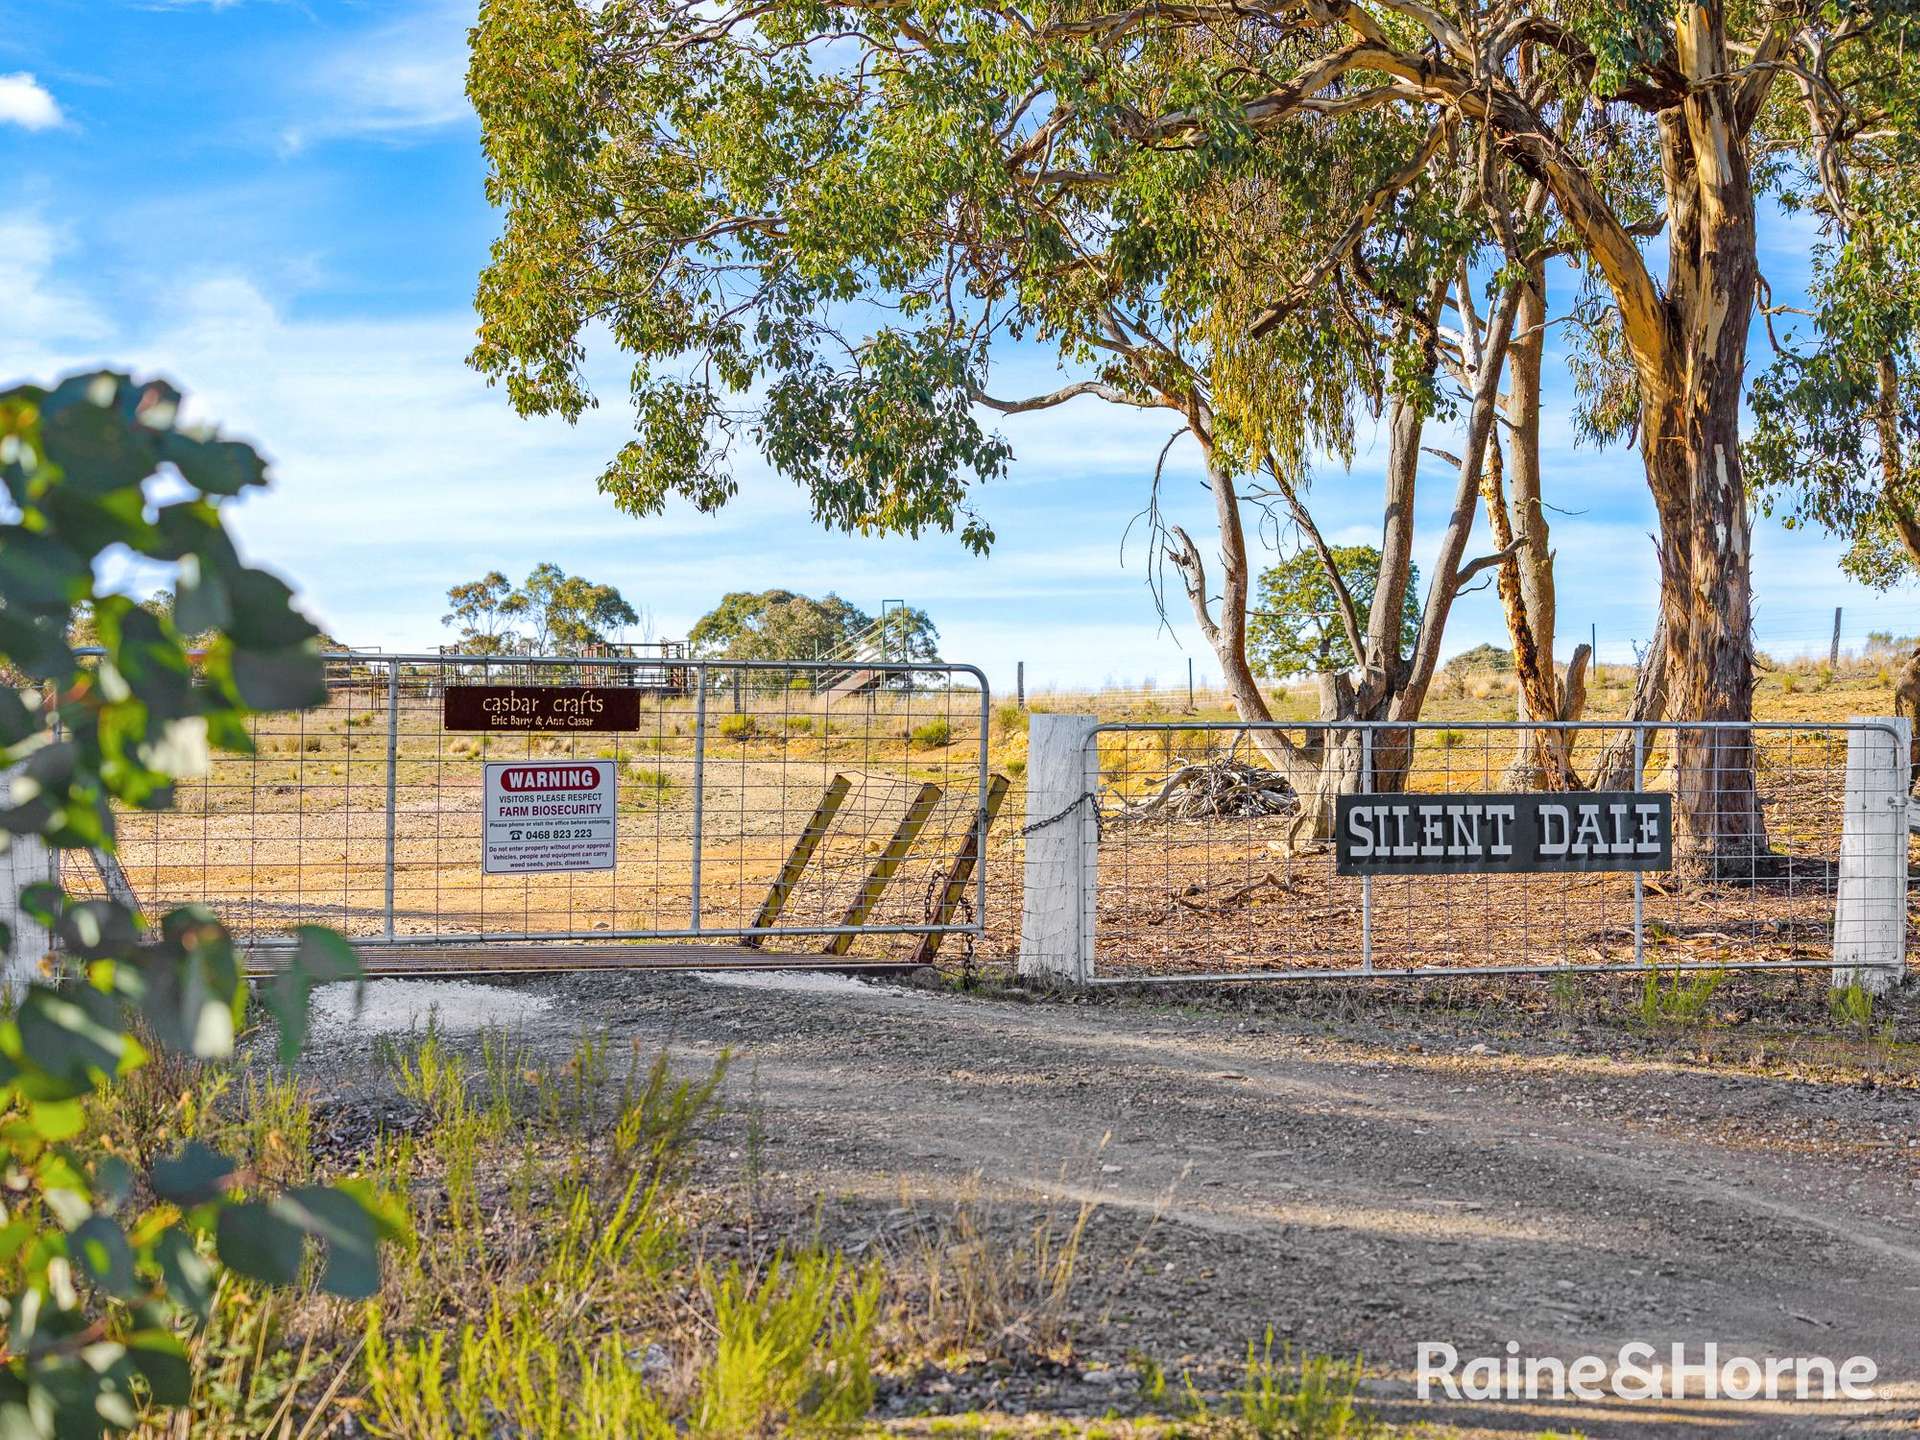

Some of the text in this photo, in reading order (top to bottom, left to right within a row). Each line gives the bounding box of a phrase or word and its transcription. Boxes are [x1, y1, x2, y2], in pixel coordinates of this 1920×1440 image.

[482, 690, 604, 715] casbar crafts
[491, 715, 594, 729] Eric Barry & Ann Cassar
[508, 770, 593, 789] WARNING
[499, 792, 602, 804] VISITORS PLEASE RESPECT
[499, 804, 602, 817] FARM BIOSECURITY
[525, 828, 593, 840] 0468 823 223
[1349, 803, 1661, 857] SILENT DALE
[524, 844, 549, 852] property
[571, 842, 585, 850] prior
[519, 853, 539, 861] people
[551, 851, 581, 859] equipment
[593, 850, 608, 858] carry
